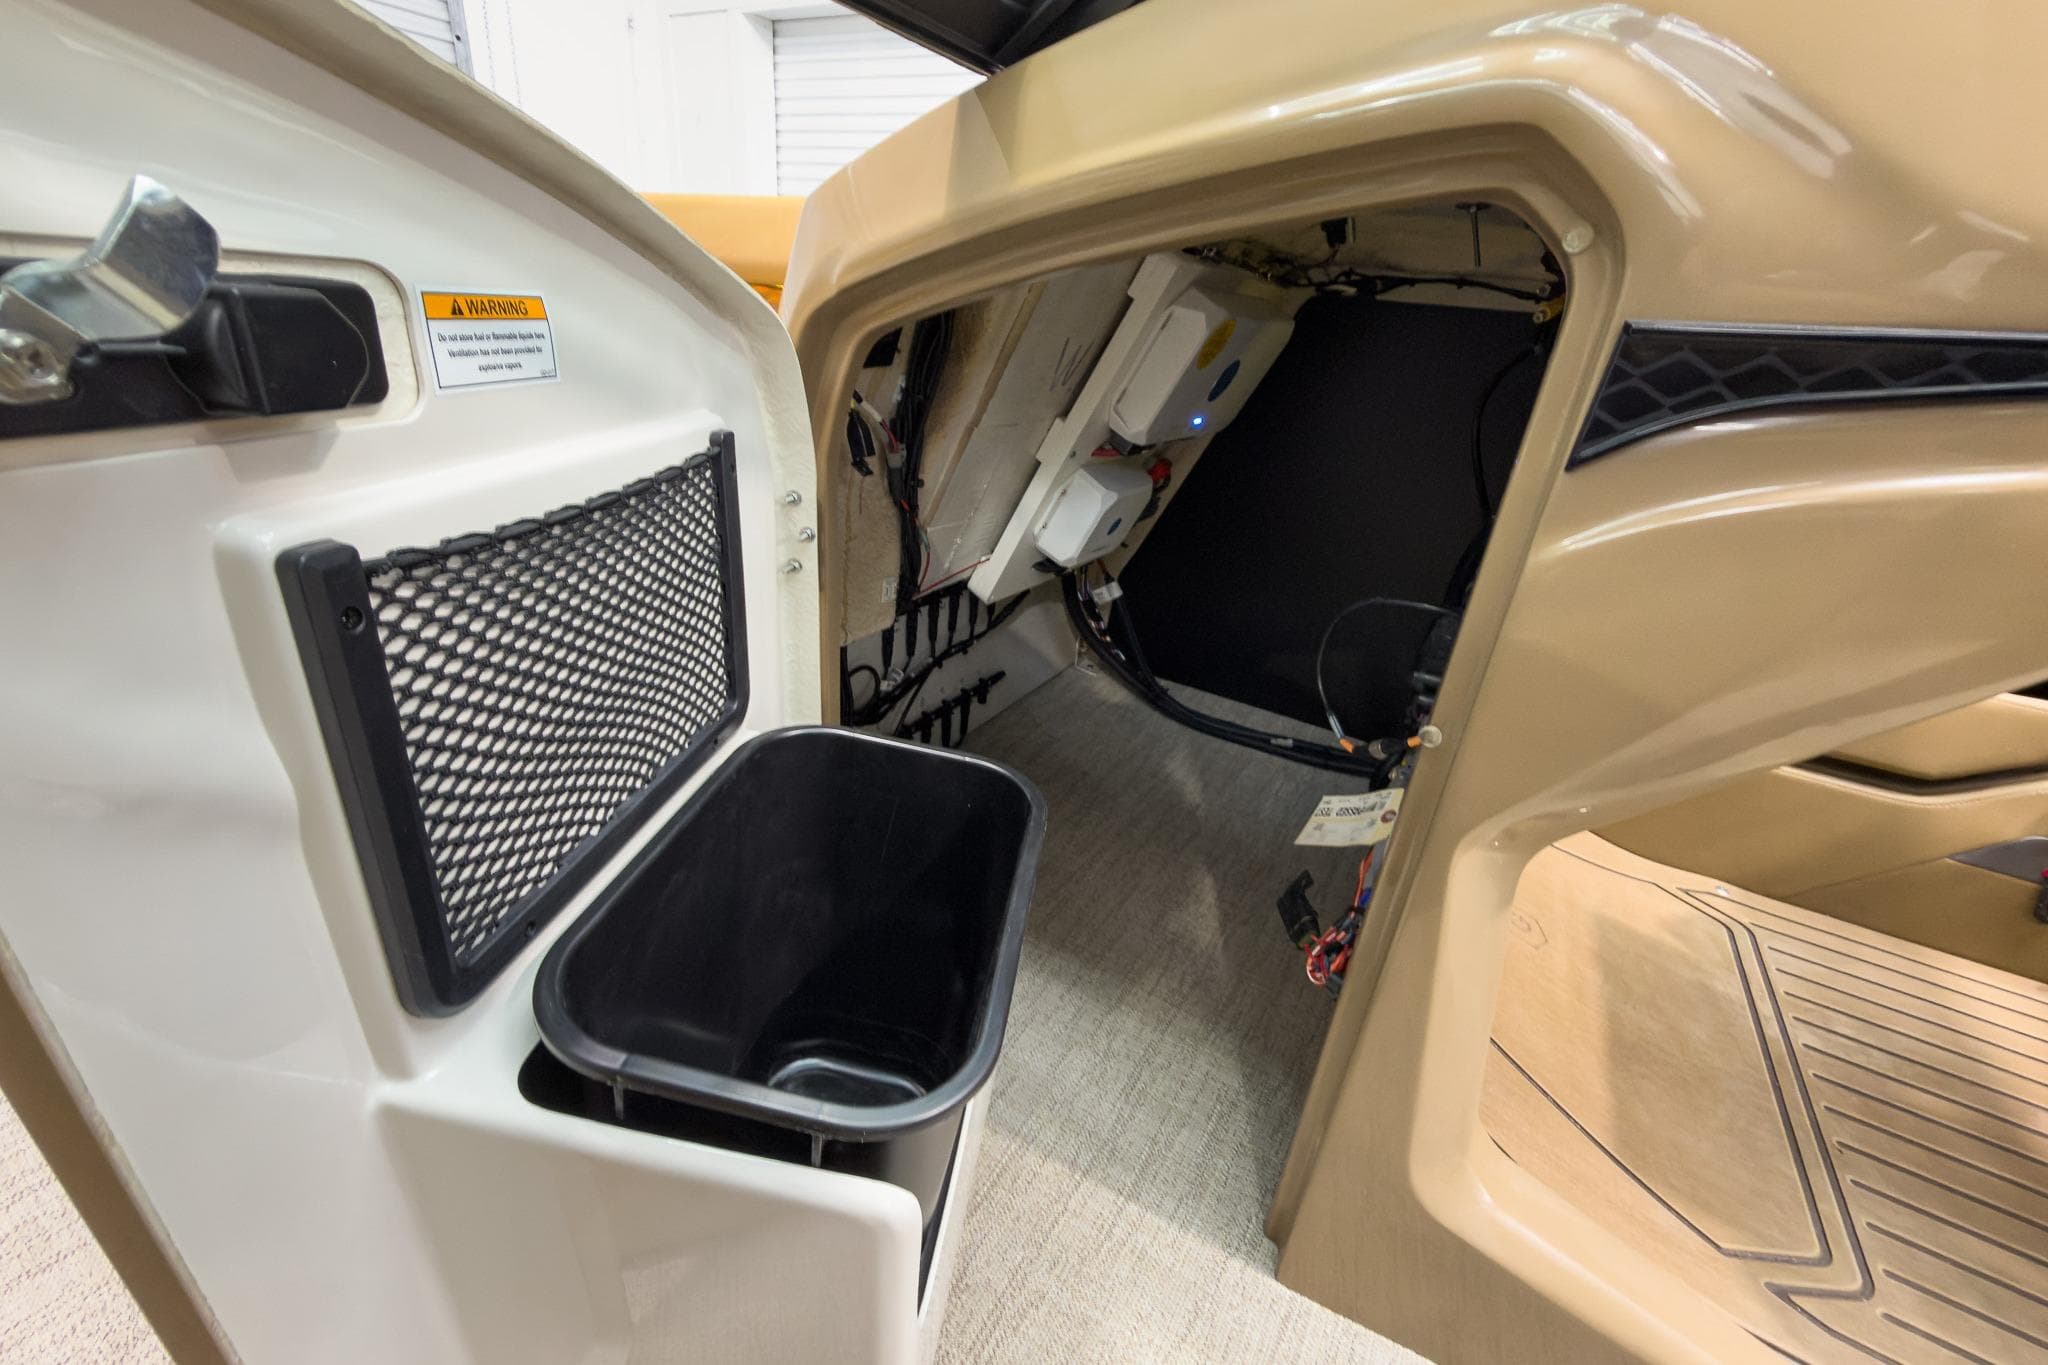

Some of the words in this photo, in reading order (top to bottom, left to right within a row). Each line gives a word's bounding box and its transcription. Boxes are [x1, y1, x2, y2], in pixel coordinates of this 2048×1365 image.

[465, 299, 528, 316] WARNING
[438, 333, 447, 342] Do
[448, 333, 458, 341] not
[459, 332, 473, 341] store
[474, 331, 485, 341] fuel
[448, 347, 479, 358] Ventilation
[480, 347, 490, 356] has
[491, 347, 500, 355] not
[500, 346, 513, 355] been
[514, 345, 536, 356] provided
[478, 362, 503, 372] explosive
